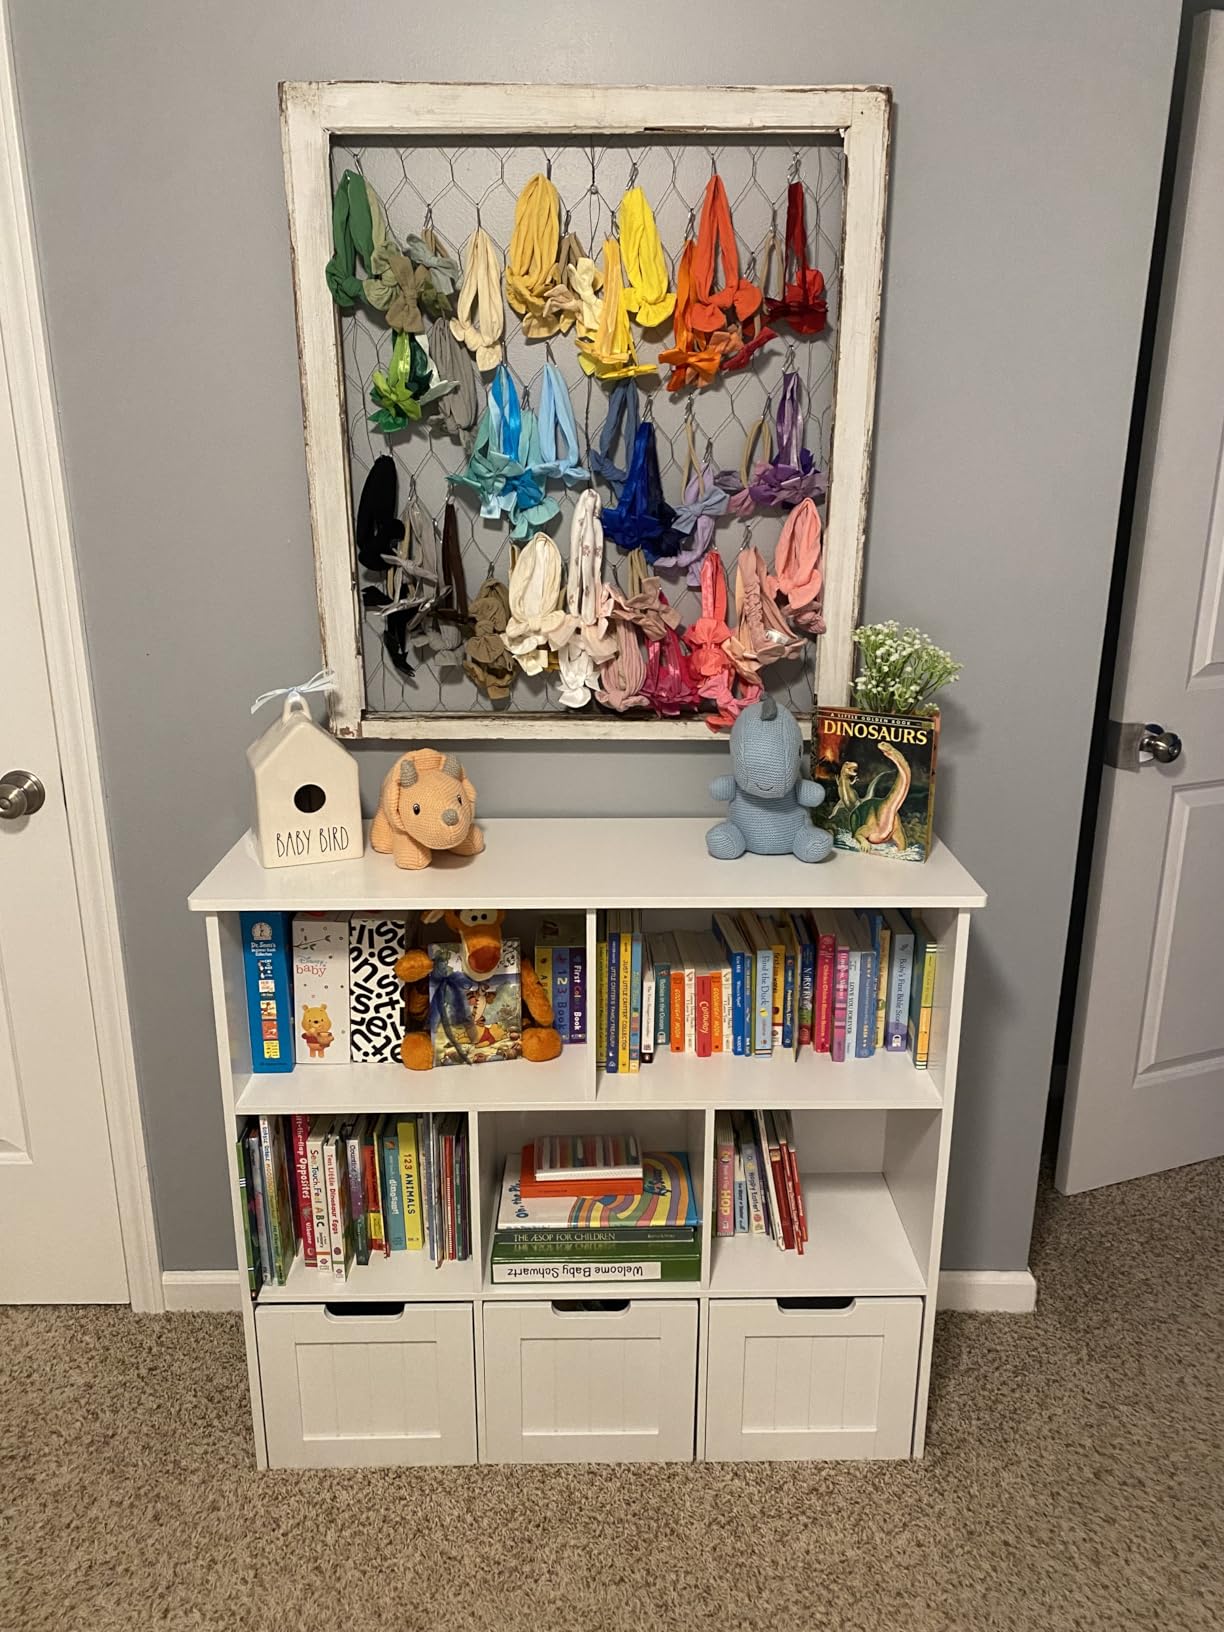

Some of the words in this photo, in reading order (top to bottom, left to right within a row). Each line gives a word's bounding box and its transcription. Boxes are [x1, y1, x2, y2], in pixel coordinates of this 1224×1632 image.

[861, 716, 888, 724] GOLDEN
[824, 720, 928, 745] DINOSAURS
[276, 830, 312, 858] BABY
[320, 826, 349, 853] BIRD
[296, 964, 327, 977] baby
[761, 956, 769, 971] Find
[897, 958, 907, 977] Baby's
[574, 966, 582, 983] First
[761, 973, 769, 985] the
[896, 979, 905, 992] First
[761, 986, 769, 1006] Duck
[895, 993, 904, 1008] Bible
[557, 1002, 568, 1030] Book
[574, 1012, 582, 1030] Book
[325, 1154, 334, 1166] Ten
[403, 1153, 413, 1171] 123
[327, 1167, 336, 1187] Little
[296, 1157, 310, 1199] Opposites
[305, 1222, 313, 1244] Usborne
[312, 1187, 322, 1204] Feel
[404, 1173, 416, 1215] ANIMALS
[719, 1190, 730, 1215] HOP
[329, 1188, 339, 1218] Dinosaur
[331, 1219, 340, 1235] Eggs
[514, 1234, 528, 1242] THE
[556, 1233, 573, 1241] FOR
[574, 1233, 616, 1241] CHILDREN
[507, 1267, 560, 1278] Schwartz
[562, 1265, 591, 1278] Baby
[594, 1265, 643, 1277] Welcome
